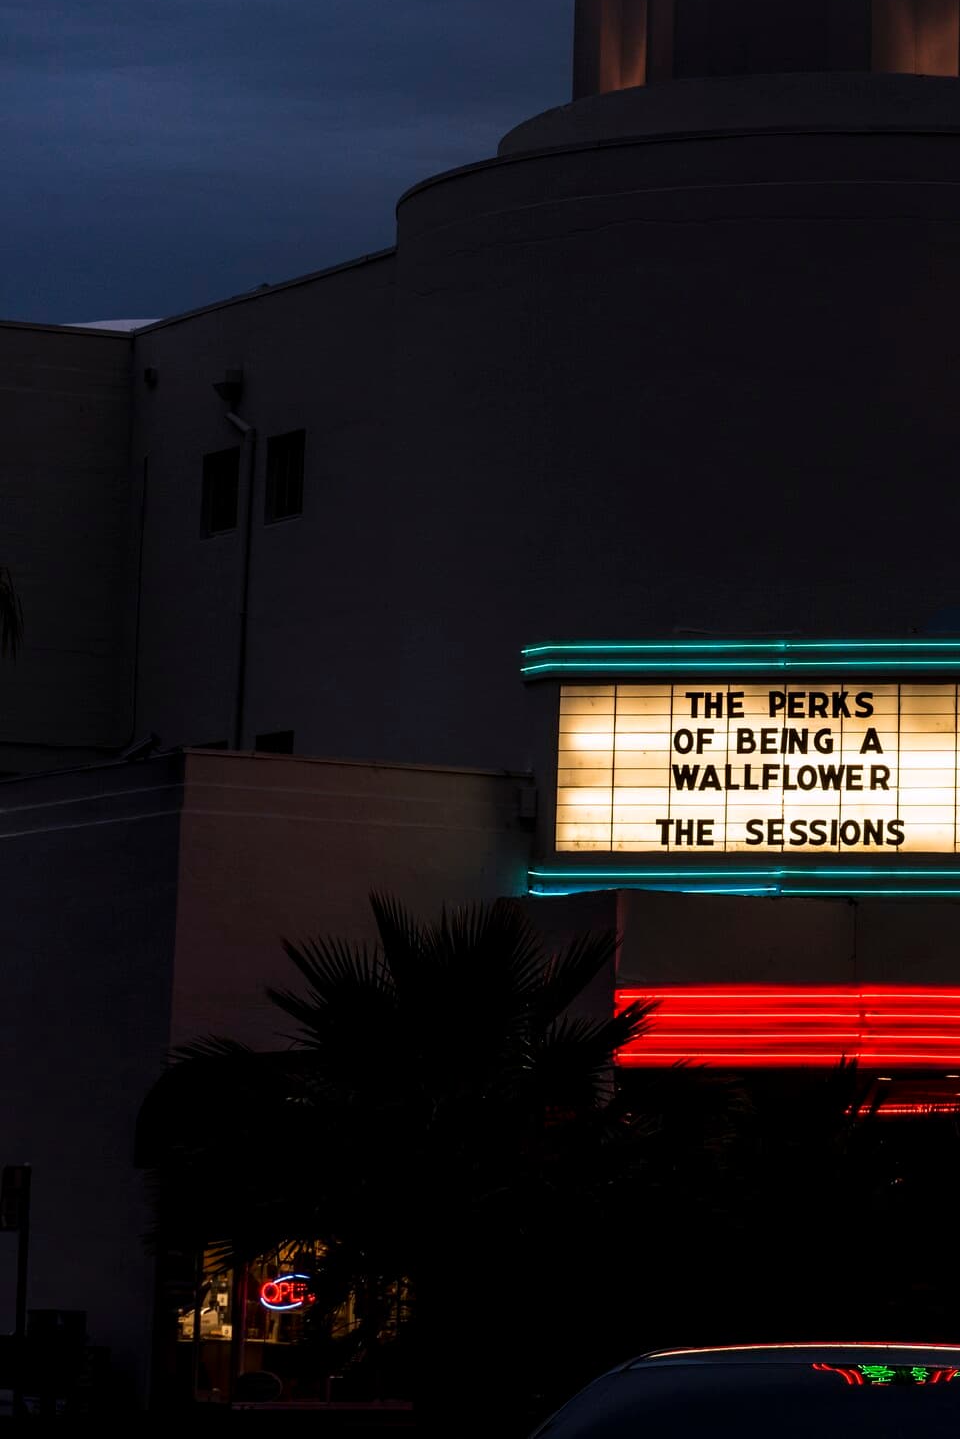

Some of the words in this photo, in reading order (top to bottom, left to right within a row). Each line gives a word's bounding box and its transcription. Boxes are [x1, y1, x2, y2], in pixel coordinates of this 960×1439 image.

[685, 691, 745, 719] THE
[768, 691, 875, 718] PERKS
[672, 728, 714, 755] OF
[736, 728, 834, 755] BEING
[859, 728, 884, 755] A
[671, 764, 891, 792] WALLFLOWER
[655, 819, 714, 847] THE
[745, 819, 906, 846] SESSIONS
[262, 1282, 316, 1303] OPE
